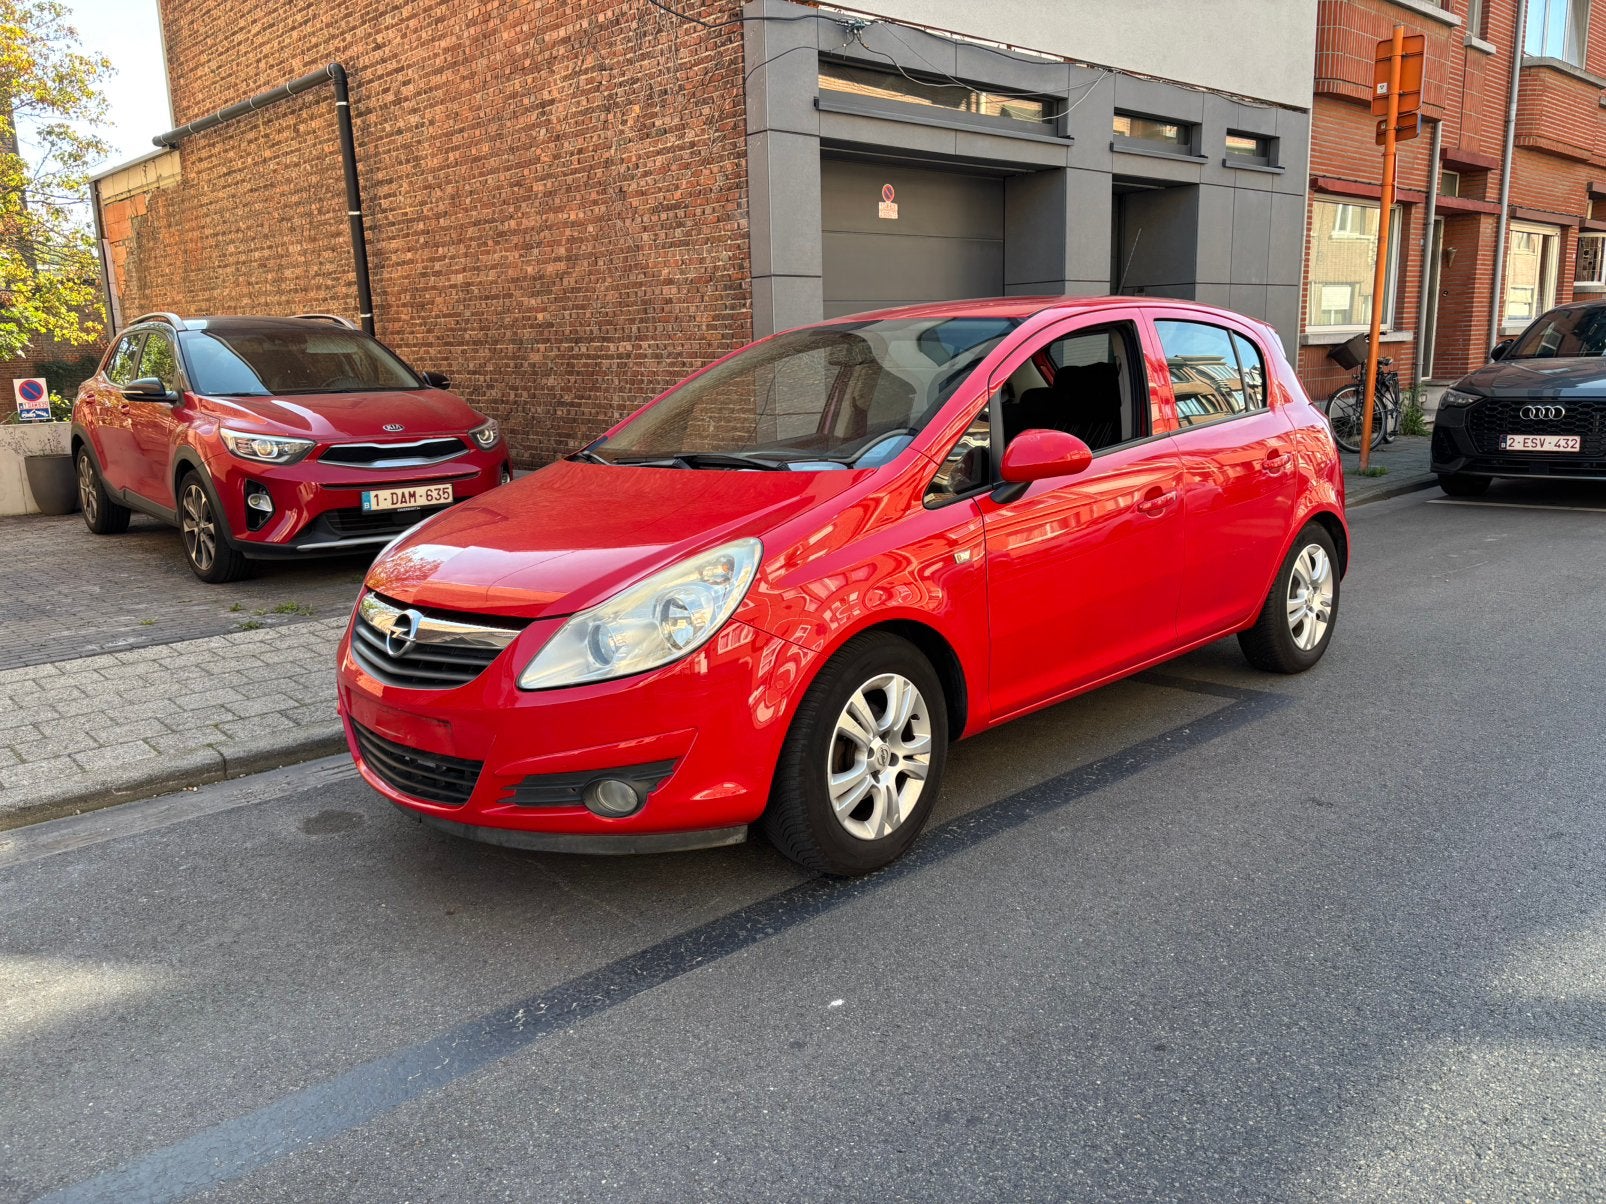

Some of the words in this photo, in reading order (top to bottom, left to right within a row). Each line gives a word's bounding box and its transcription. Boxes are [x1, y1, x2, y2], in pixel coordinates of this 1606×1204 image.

[383, 424, 404, 432] KIA
[1508, 437, 1578, 449] 2-ESV-432
[373, 487, 450, 507] 1-DAM-635
